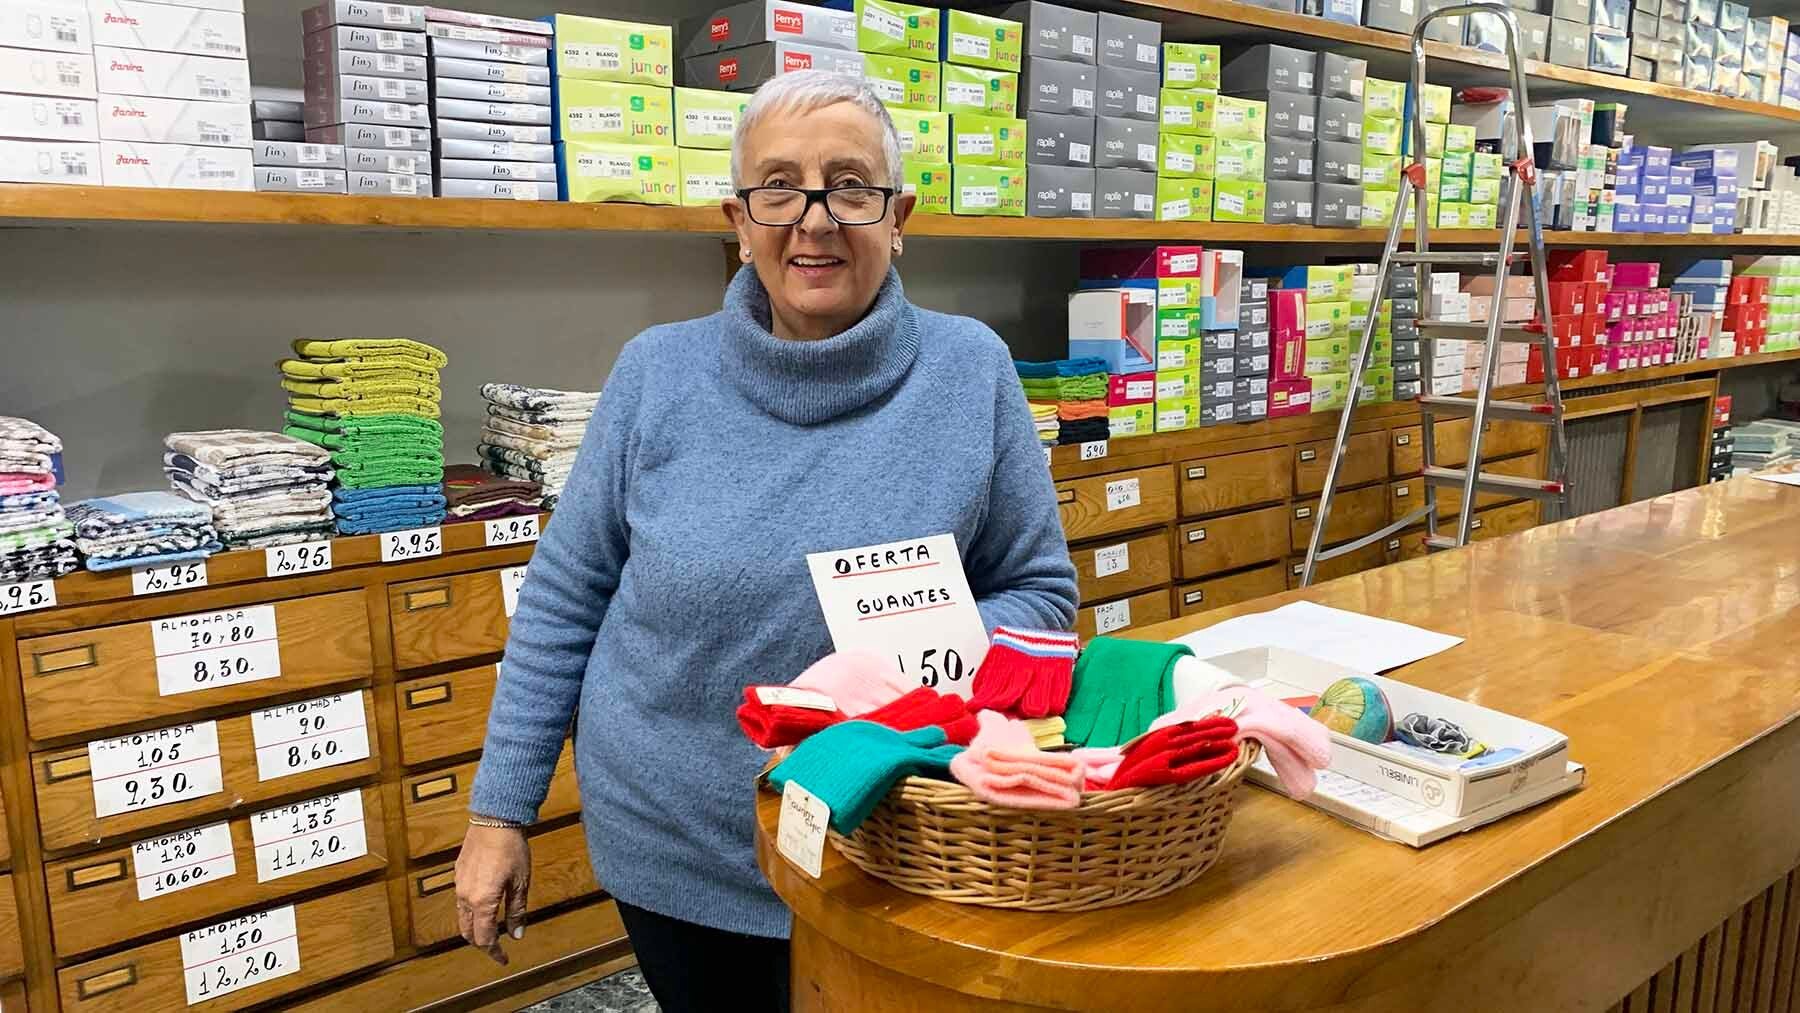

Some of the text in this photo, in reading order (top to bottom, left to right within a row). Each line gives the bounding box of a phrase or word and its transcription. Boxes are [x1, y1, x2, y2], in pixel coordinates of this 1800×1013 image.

[104, 13, 139, 26] Janira
[711, 21, 729, 34] Ferry's
[775, 13, 802, 27] Ferry's
[908, 35, 936, 51] junor
[995, 47, 1019, 63] junor
[110, 60, 144, 72] Janira
[631, 57, 668, 75] junor
[719, 61, 737, 75] Ferry's
[785, 55, 811, 68] Ferry's
[910, 89, 936, 104] junor
[112, 106, 147, 117] Janira
[631, 120, 669, 136] junor
[116, 154, 151, 165] Janira
[918, 143, 944, 154] junor
[641, 179, 676, 195] junor
[921, 192, 948, 205] junor
[491, 519, 537, 542] 2,95.
[391, 532, 440, 557] 2,95.
[276, 546, 329, 572] 2,95.
[834, 544, 931, 575] OFERTA
[145, 562, 205, 590] 2,95.
[0, 583, 50, 612] ,95.
[856, 587, 951, 615] GUANTES
[161, 611, 244, 631] ALMOHADA
[191, 631, 212, 649] 70
[230, 625, 254, 642] 80
[193, 657, 255, 682] 8,30.
[263, 694, 342, 720] ALMOHADA
[97, 724, 195, 750] ALMOHADA
[299, 715, 325, 735] 90
[137, 743, 181, 768] 1,05
[288, 740, 343, 768] 8,60.
[125, 772, 194, 806] 9,30.
[260, 793, 340, 823] ALMOHADA
[292, 808, 336, 834] 1,35
[136, 828, 202, 854] ALMOHADA
[161, 842, 196, 864] 120
[273, 835, 346, 871] 11,20.
[155, 866, 209, 892] 10,60.
[188, 911, 269, 943] ALMOHADA
[220, 928, 263, 955] 1,50
[198, 951, 283, 996] 12,20.
